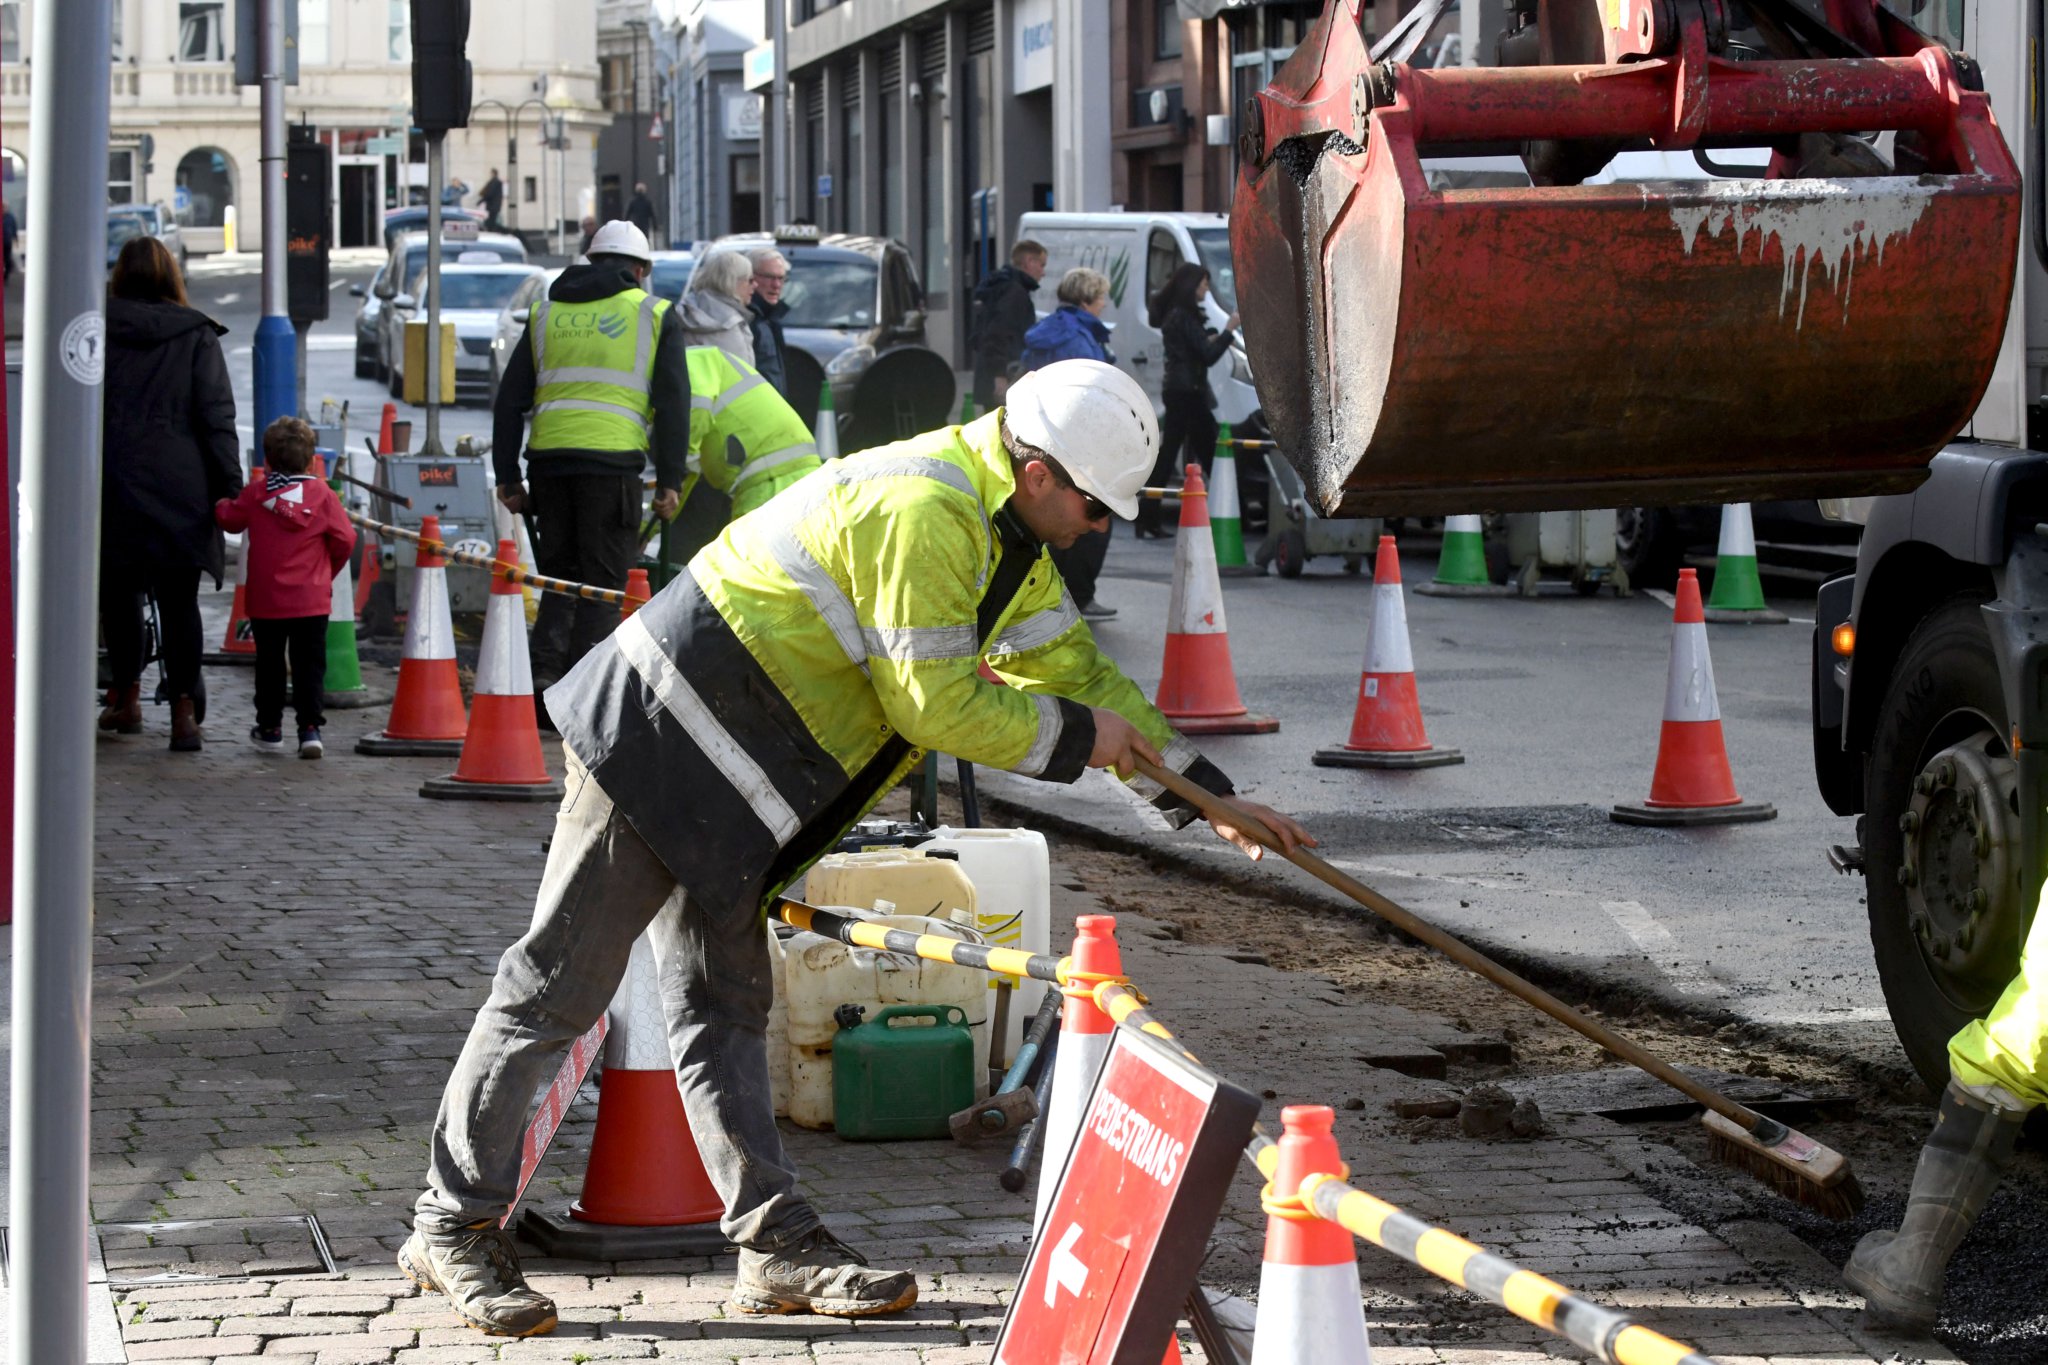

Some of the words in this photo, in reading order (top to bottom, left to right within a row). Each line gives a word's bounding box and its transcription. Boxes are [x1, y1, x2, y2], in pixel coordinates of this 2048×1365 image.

[778, 225, 817, 238] TAXI
[555, 312, 598, 328] CCJ
[553, 330, 594, 339] GROUP
[419, 467, 454, 482] pike
[1089, 1088, 1184, 1187] PEDESTRIANS
